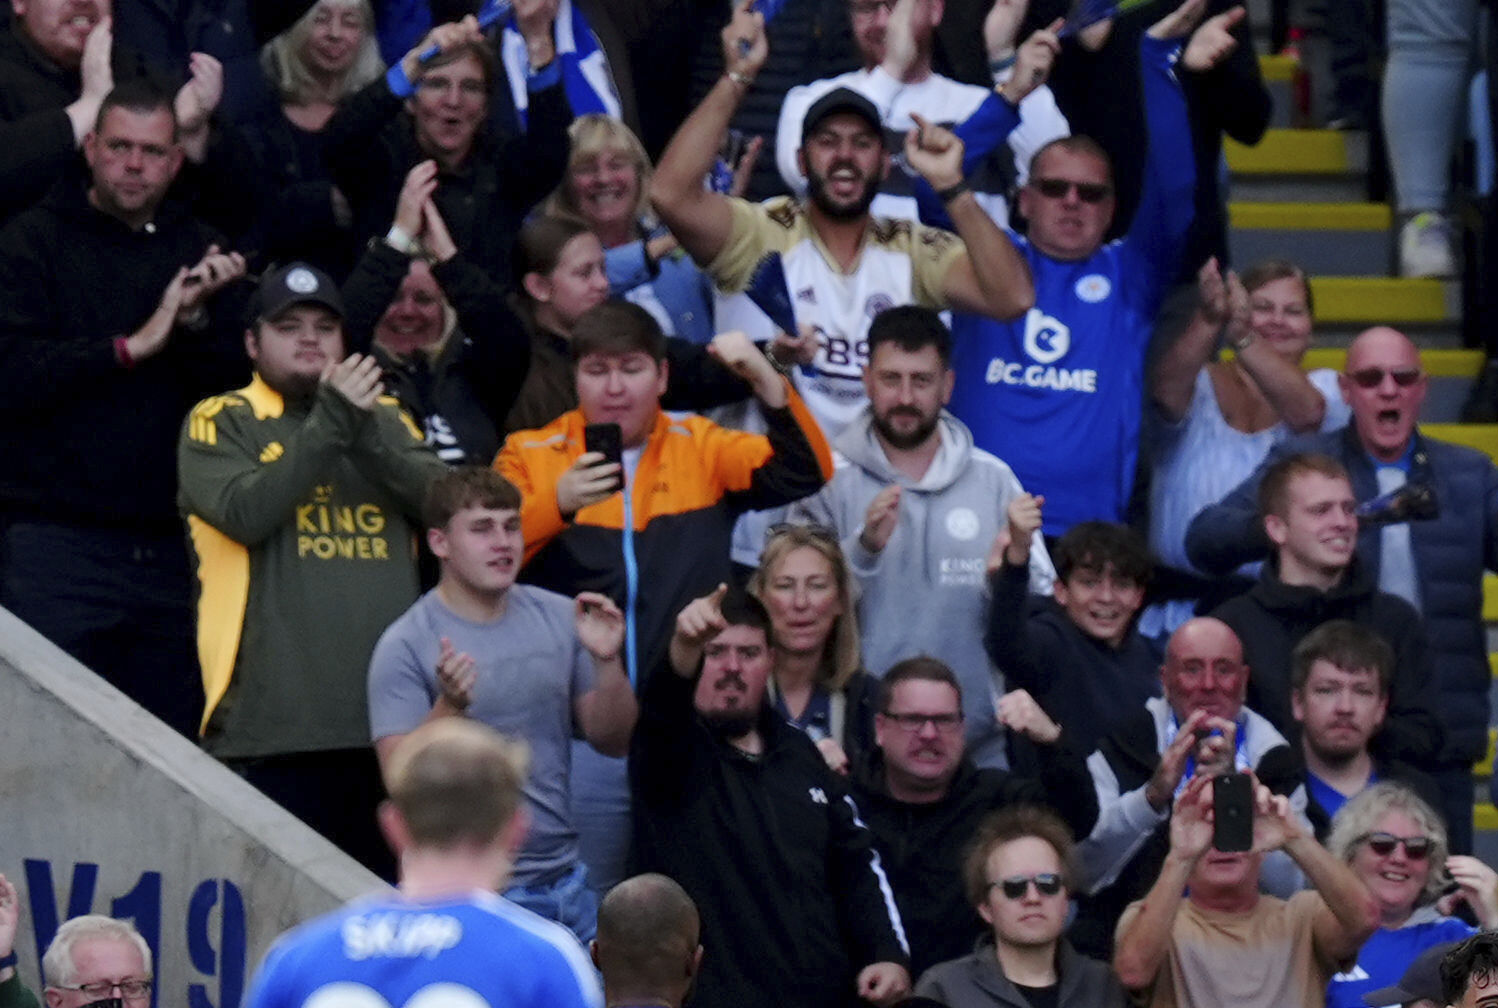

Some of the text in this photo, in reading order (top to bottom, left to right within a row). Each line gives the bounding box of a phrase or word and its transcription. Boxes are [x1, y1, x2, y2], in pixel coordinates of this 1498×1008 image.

[985, 357, 1098, 393] BC.GAME
[295, 503, 386, 534] KING
[297, 535, 390, 560] POWER
